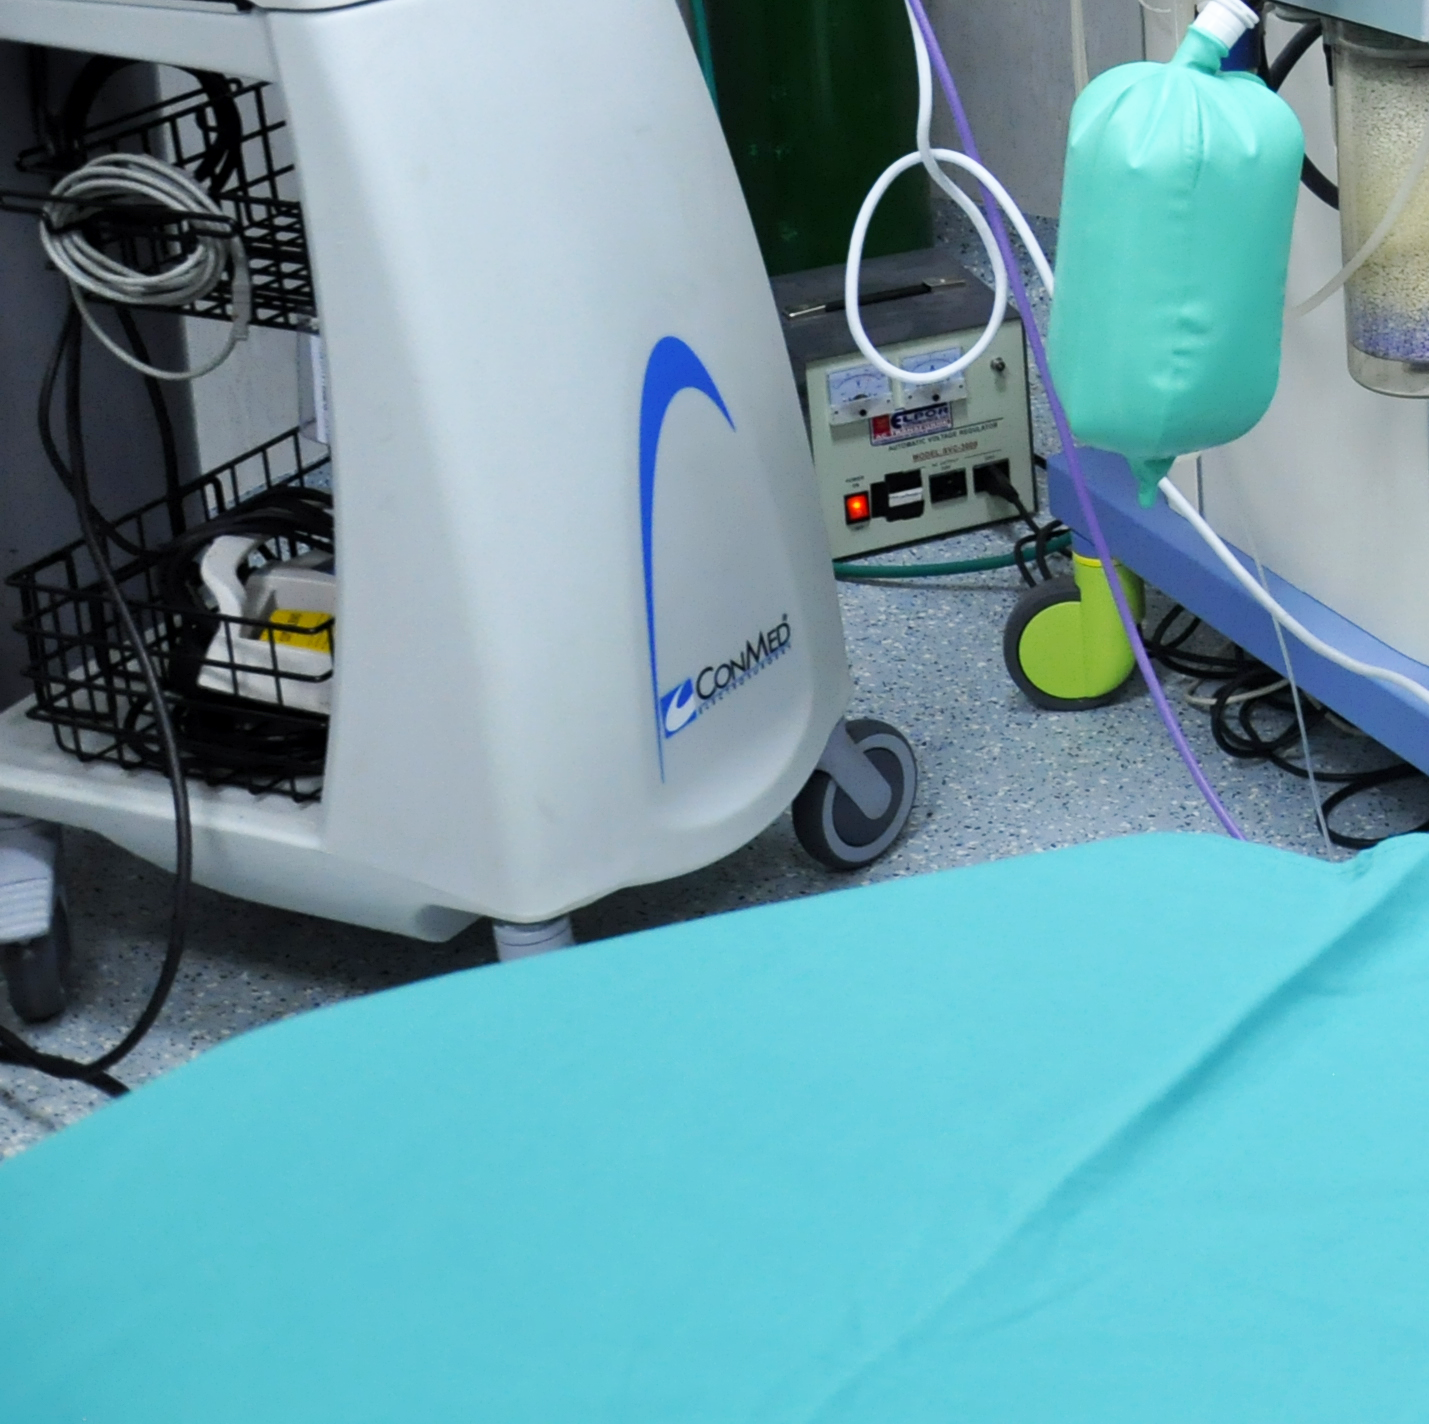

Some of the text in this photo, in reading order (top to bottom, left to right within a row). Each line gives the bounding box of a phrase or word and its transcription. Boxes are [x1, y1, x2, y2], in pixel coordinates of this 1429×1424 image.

[888, 438, 927, 451] AUTOMATIC
[928, 430, 957, 444] VOLTAGE
[958, 421, 999, 436] REGULATOR
[912, 449, 941, 462] MODEL
